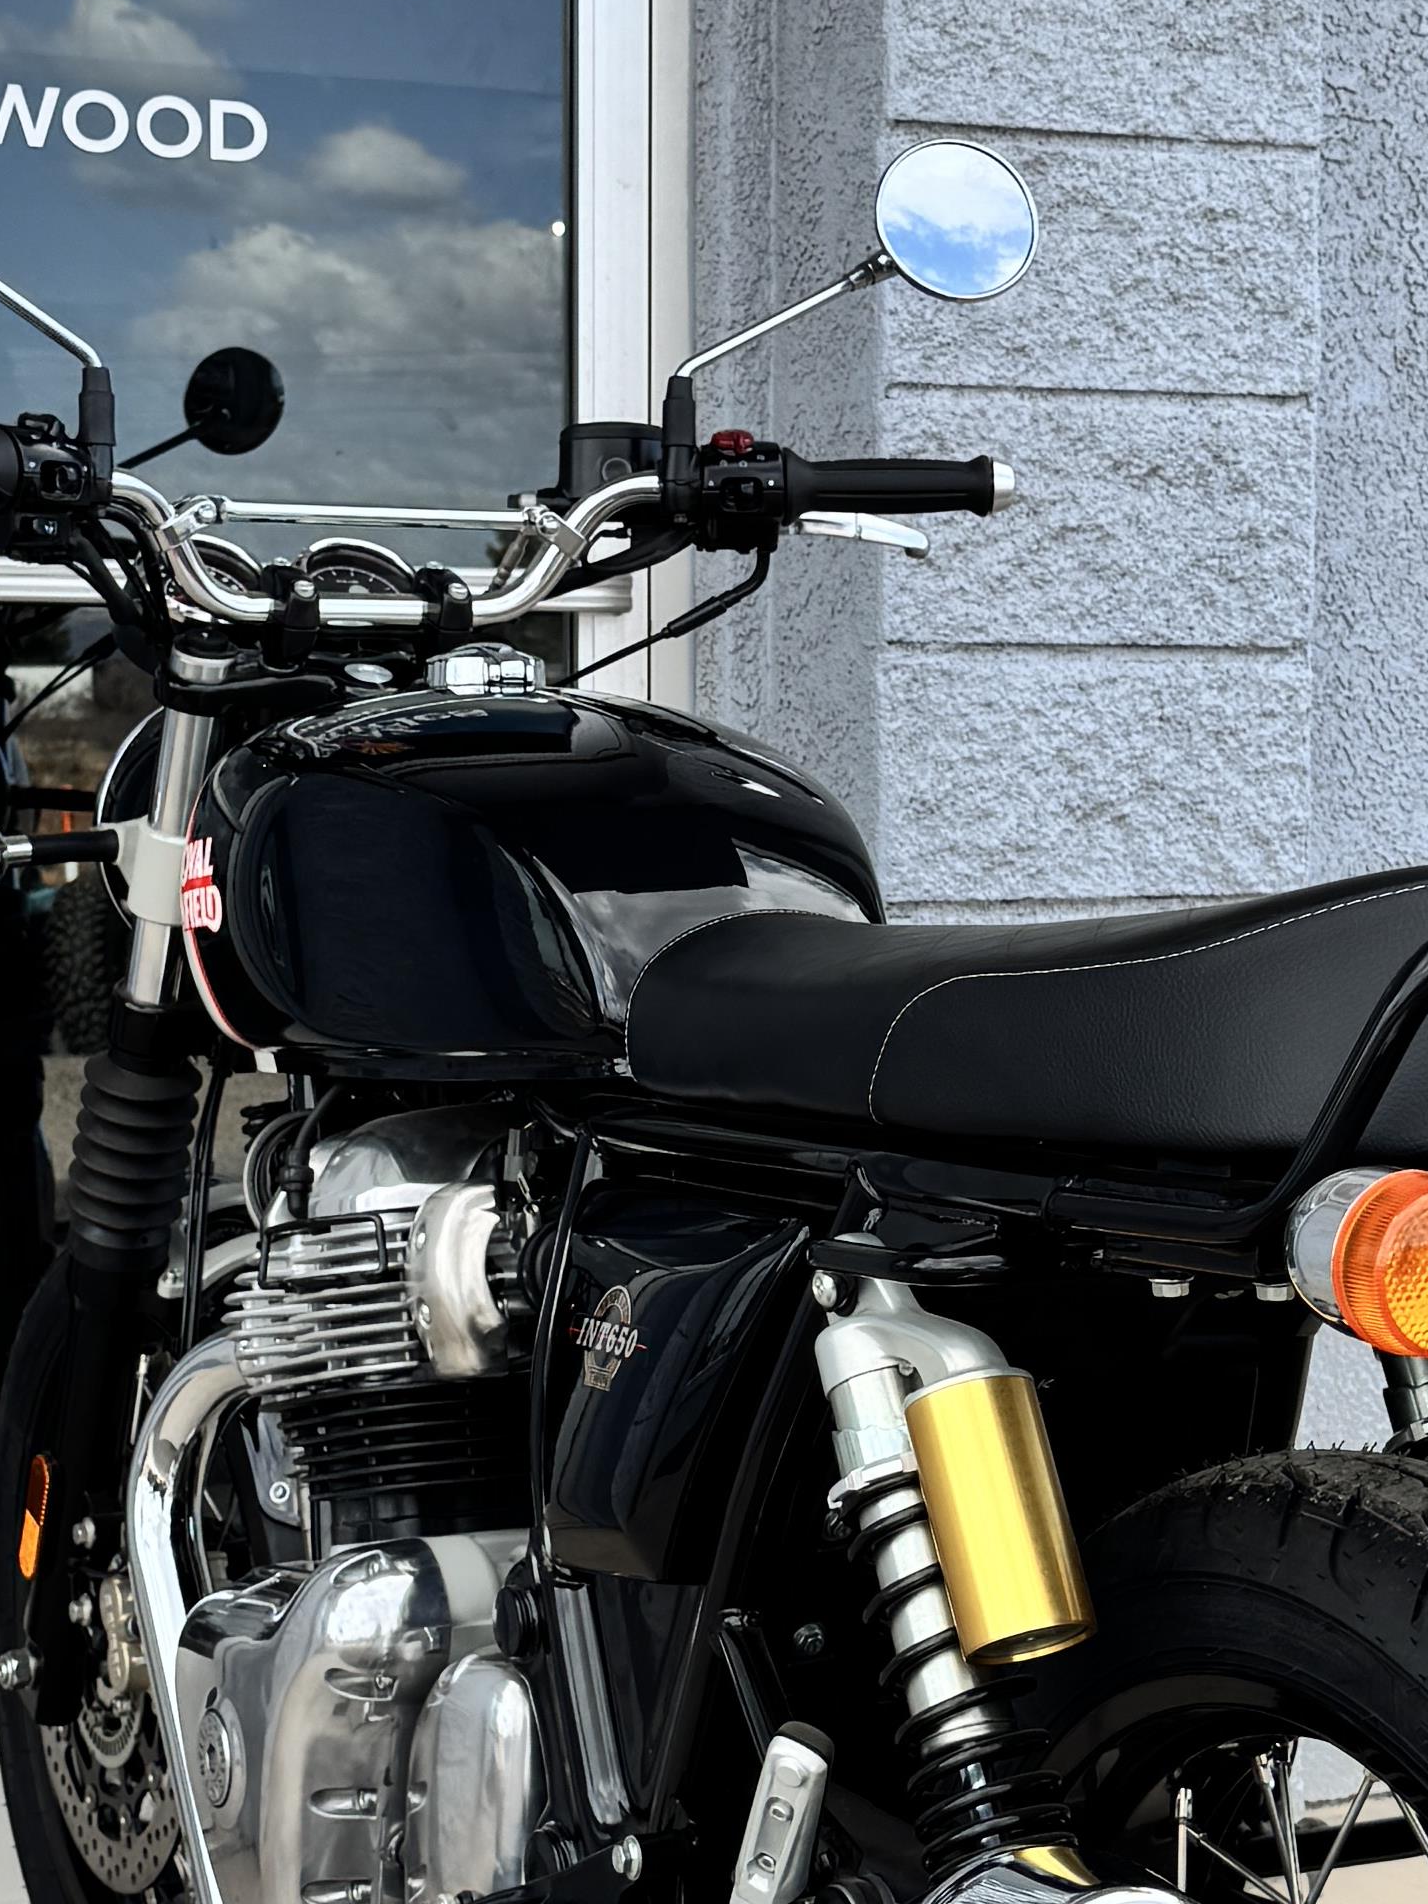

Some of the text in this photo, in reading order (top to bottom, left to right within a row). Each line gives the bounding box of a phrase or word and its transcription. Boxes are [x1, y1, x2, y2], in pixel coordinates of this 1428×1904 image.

[181, 836, 214, 887] OYAL
[180, 885, 222, 933] FIELD
[575, 1317, 639, 1358] INT650
